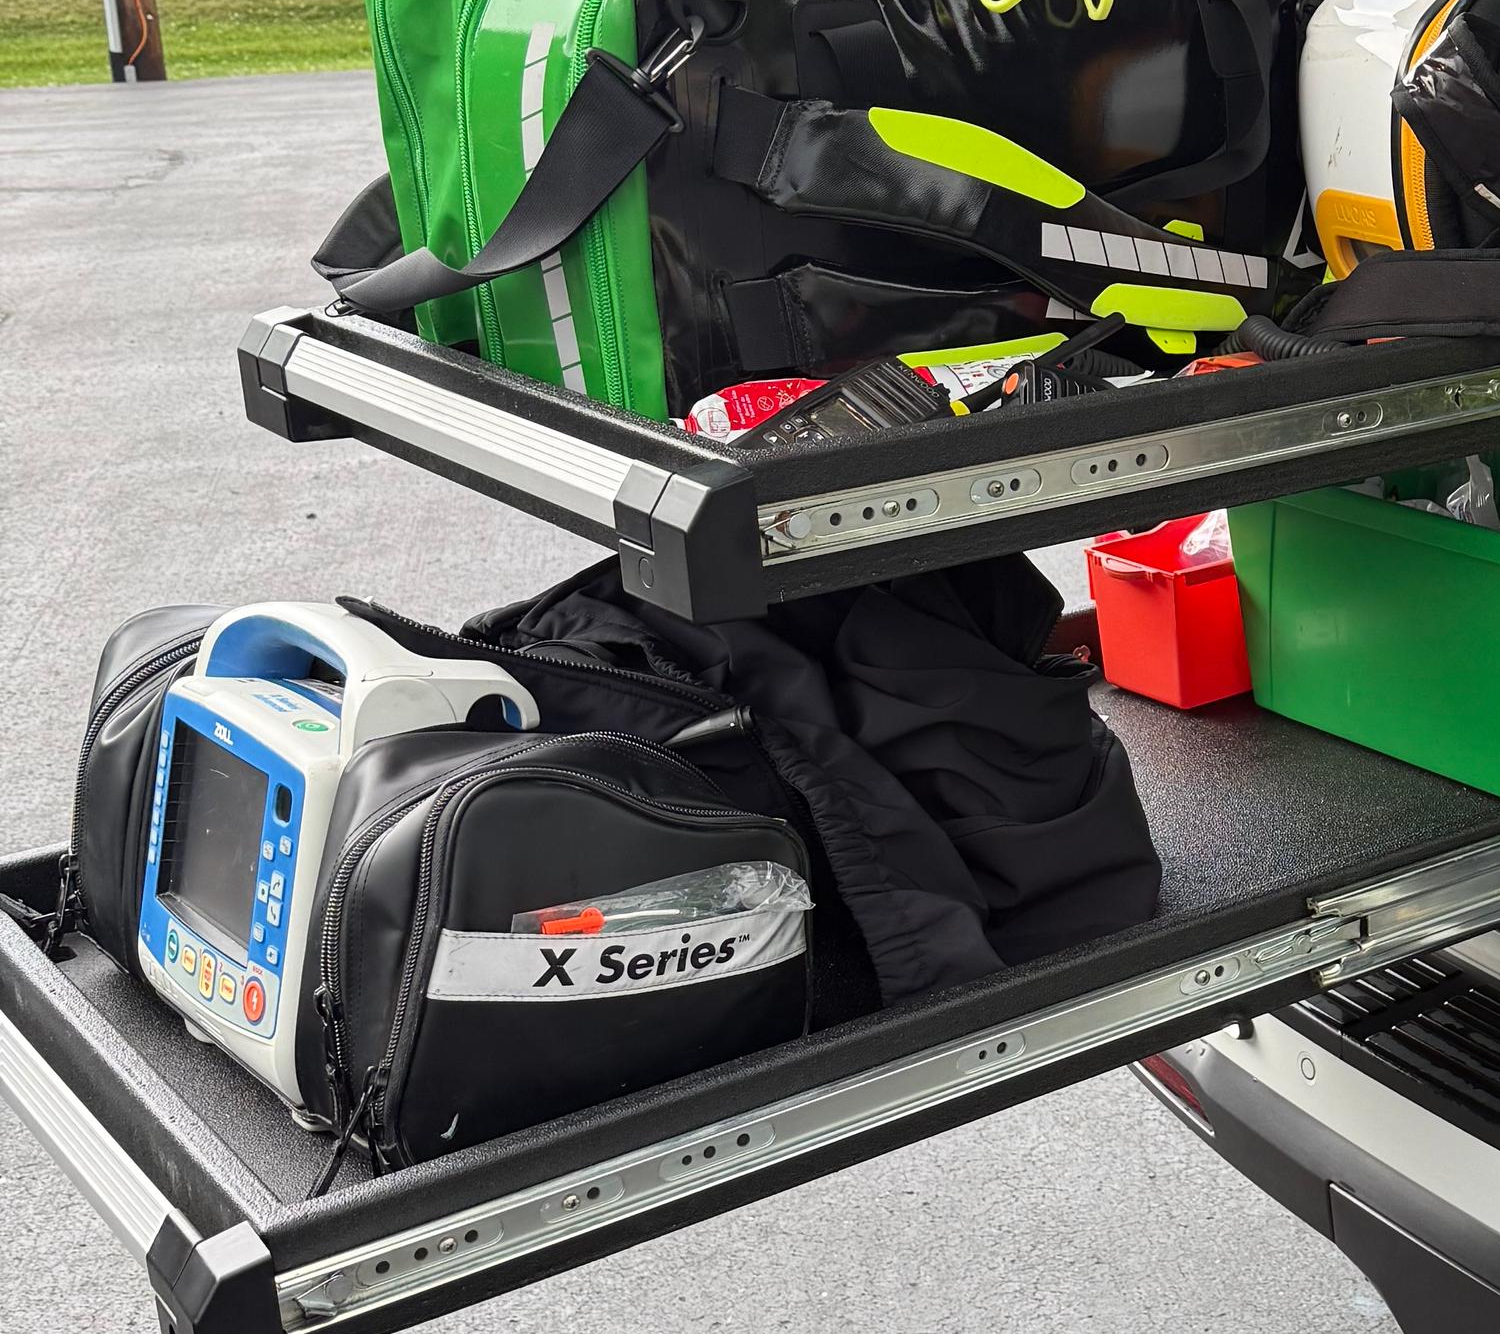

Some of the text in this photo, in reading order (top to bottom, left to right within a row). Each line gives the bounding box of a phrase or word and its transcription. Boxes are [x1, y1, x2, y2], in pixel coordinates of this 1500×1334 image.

[1334, 203, 1377, 228] LUCAS
[899, 364, 941, 399] KENWOOD
[1043, 377, 1052, 402] WOOD
[213, 721, 234, 746] ZOLL
[532, 947, 577, 987] X
